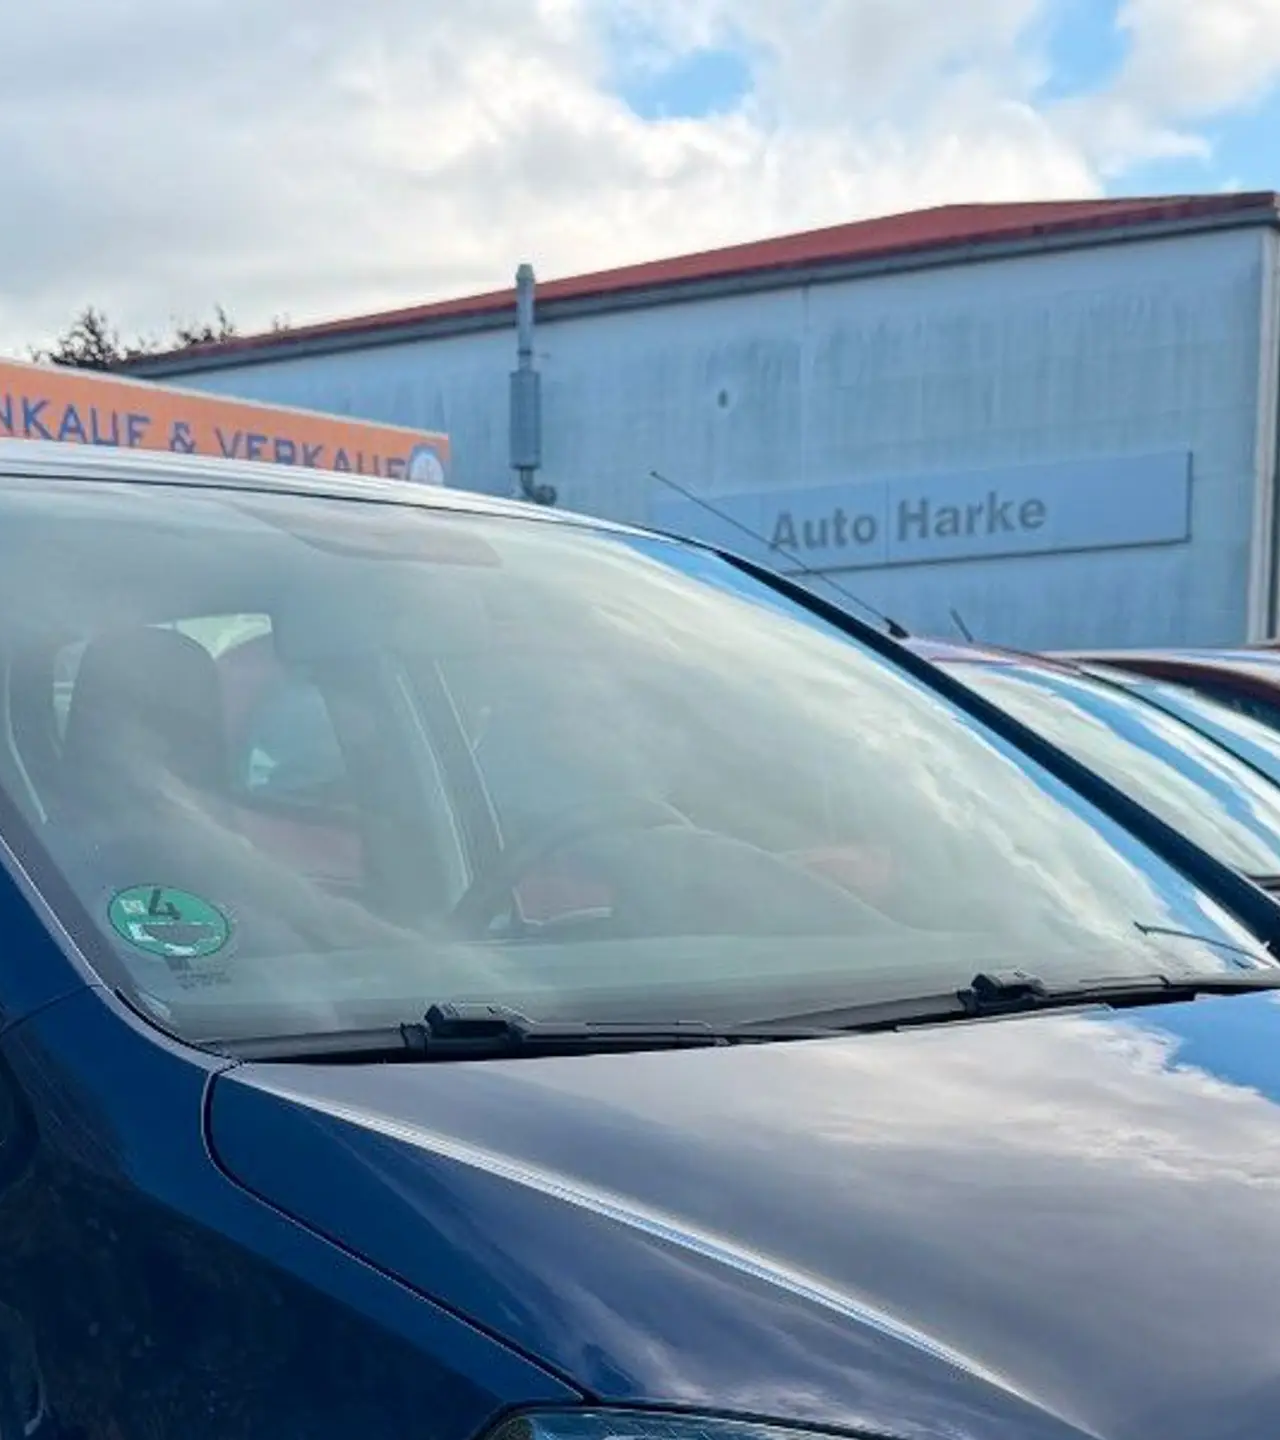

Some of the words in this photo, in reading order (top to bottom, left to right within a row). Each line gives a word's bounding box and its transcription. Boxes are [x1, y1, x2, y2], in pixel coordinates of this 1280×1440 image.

[169, 421, 196, 454] &
[770, 510, 877, 549] Auto
[897, 491, 1047, 541] Harke
